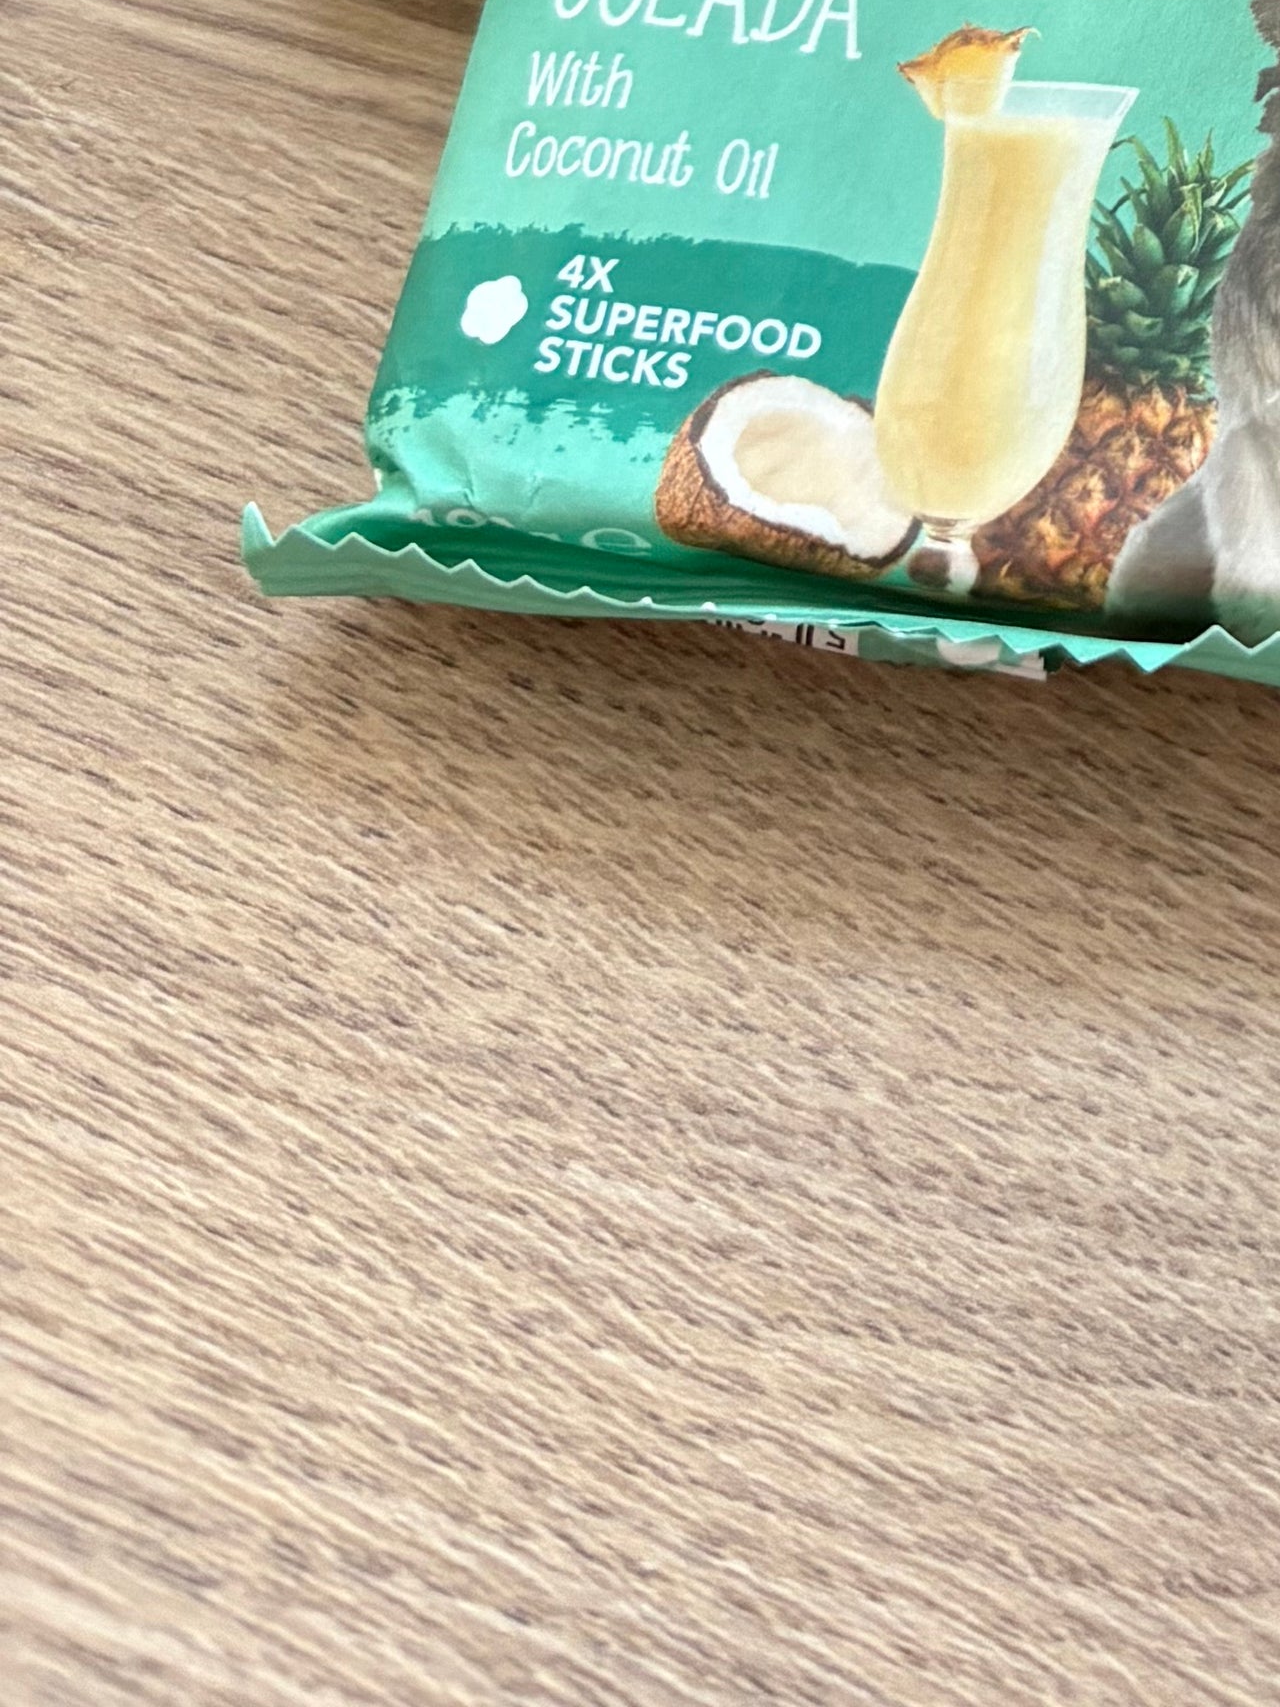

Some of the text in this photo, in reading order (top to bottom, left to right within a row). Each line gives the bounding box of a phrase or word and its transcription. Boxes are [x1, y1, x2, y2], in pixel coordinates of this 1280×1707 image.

[526, 51, 634, 109] With
[505, 121, 779, 200] Coconut Oil
[557, 254, 619, 293] 4X
[545, 295, 822, 360] SUPERFOOD
[535, 337, 693, 388] STICKS
